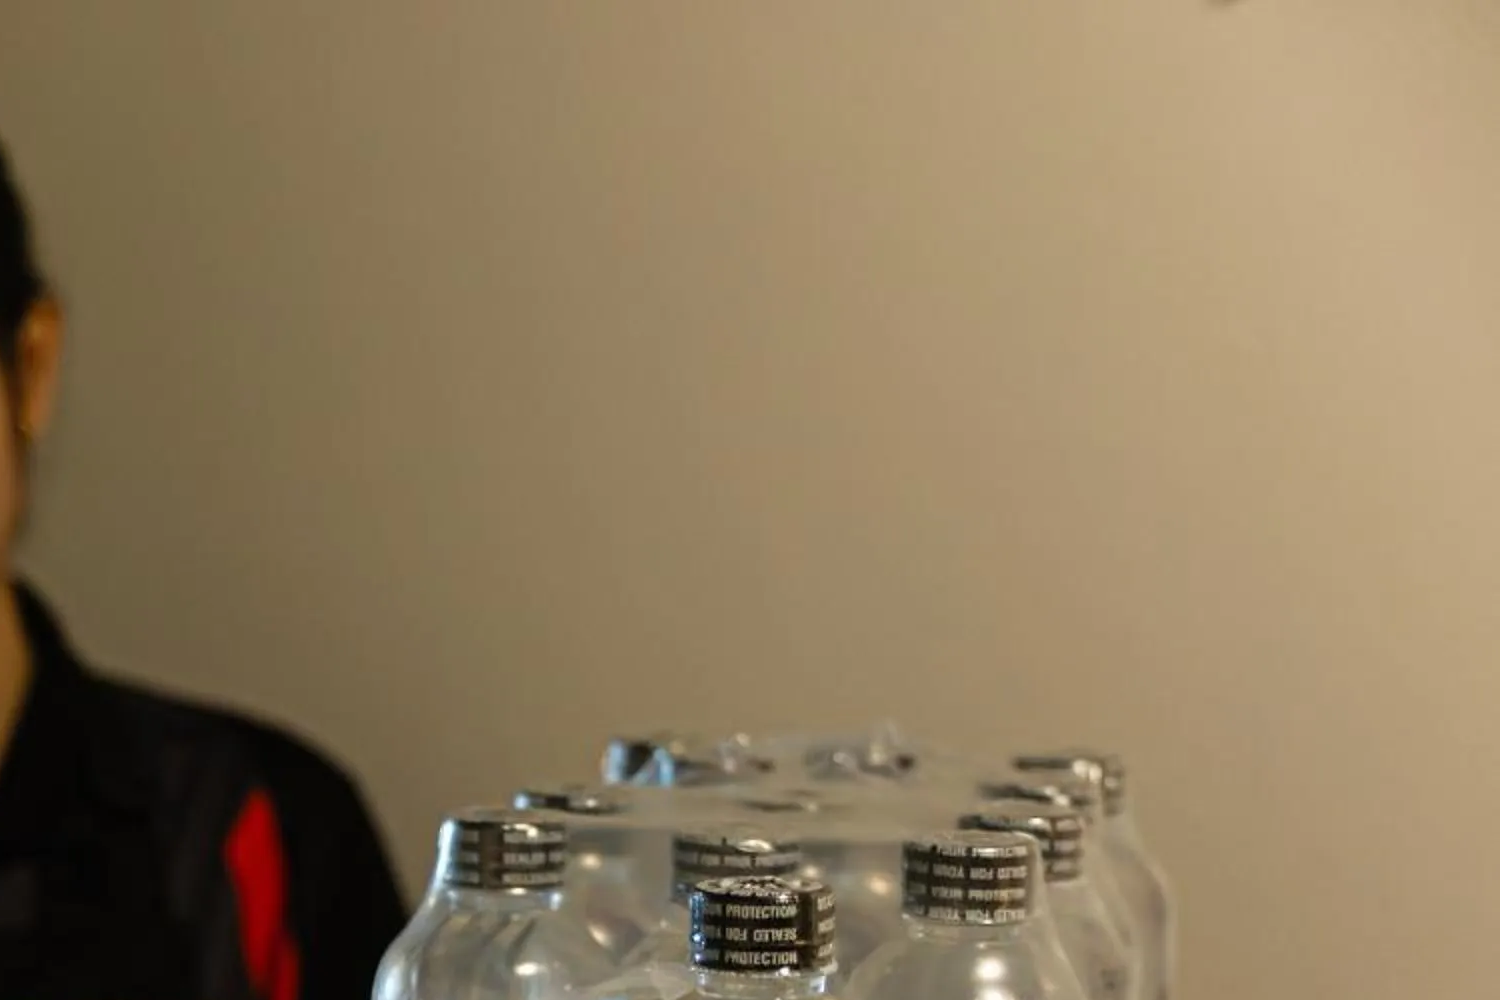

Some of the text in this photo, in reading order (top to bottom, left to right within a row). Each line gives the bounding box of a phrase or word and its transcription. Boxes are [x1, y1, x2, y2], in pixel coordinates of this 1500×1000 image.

[726, 905, 797, 919] PROTECTION
[726, 926, 797, 941] SEALED FOR
[725, 951, 798, 965] PROTECTION
